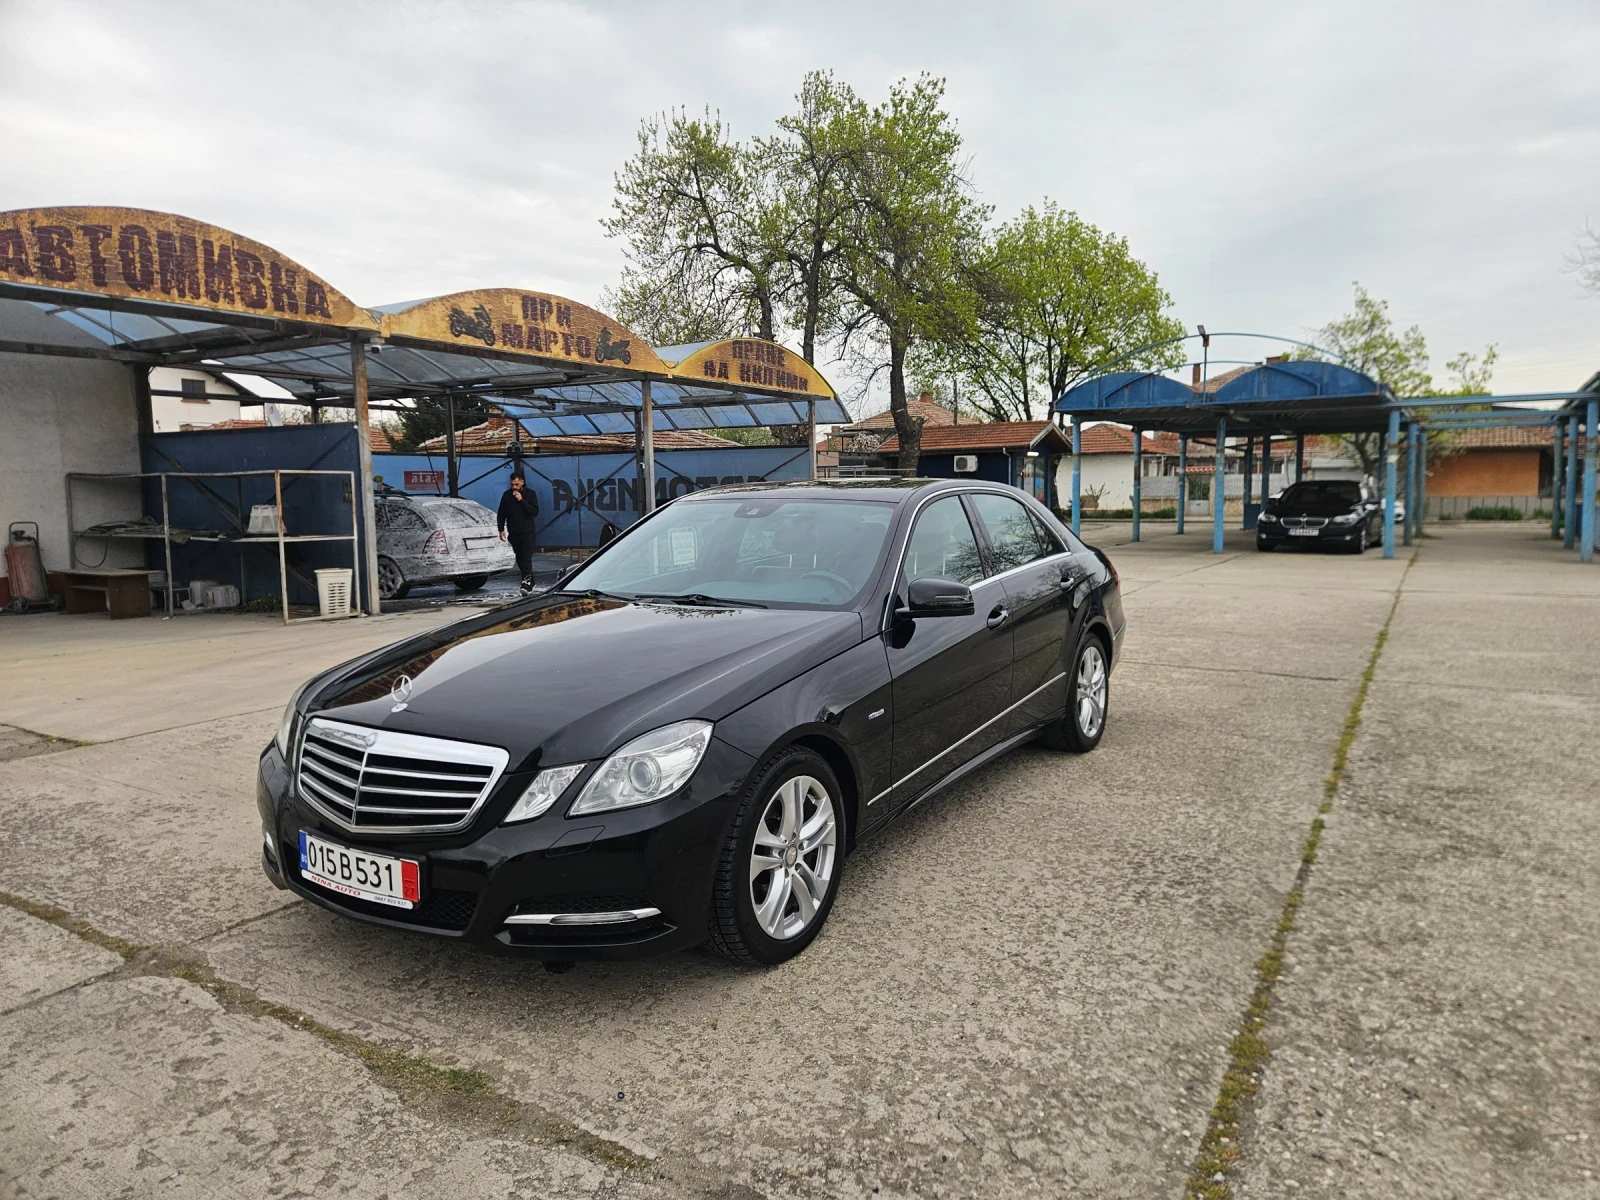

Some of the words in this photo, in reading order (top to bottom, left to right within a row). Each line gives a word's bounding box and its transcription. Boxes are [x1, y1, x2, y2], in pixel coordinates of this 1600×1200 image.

[0, 223, 332, 319] АВТОМИВКА
[521, 294, 571, 329] ПРИ
[501, 323, 591, 359] МАРТО
[732, 340, 785, 367] ПРАНЕ
[704, 360, 729, 379] НА
[740, 362, 808, 391] КИЛИМИ
[311, 874, 332, 888] NINA
[334, 884, 361, 896] AUTO
